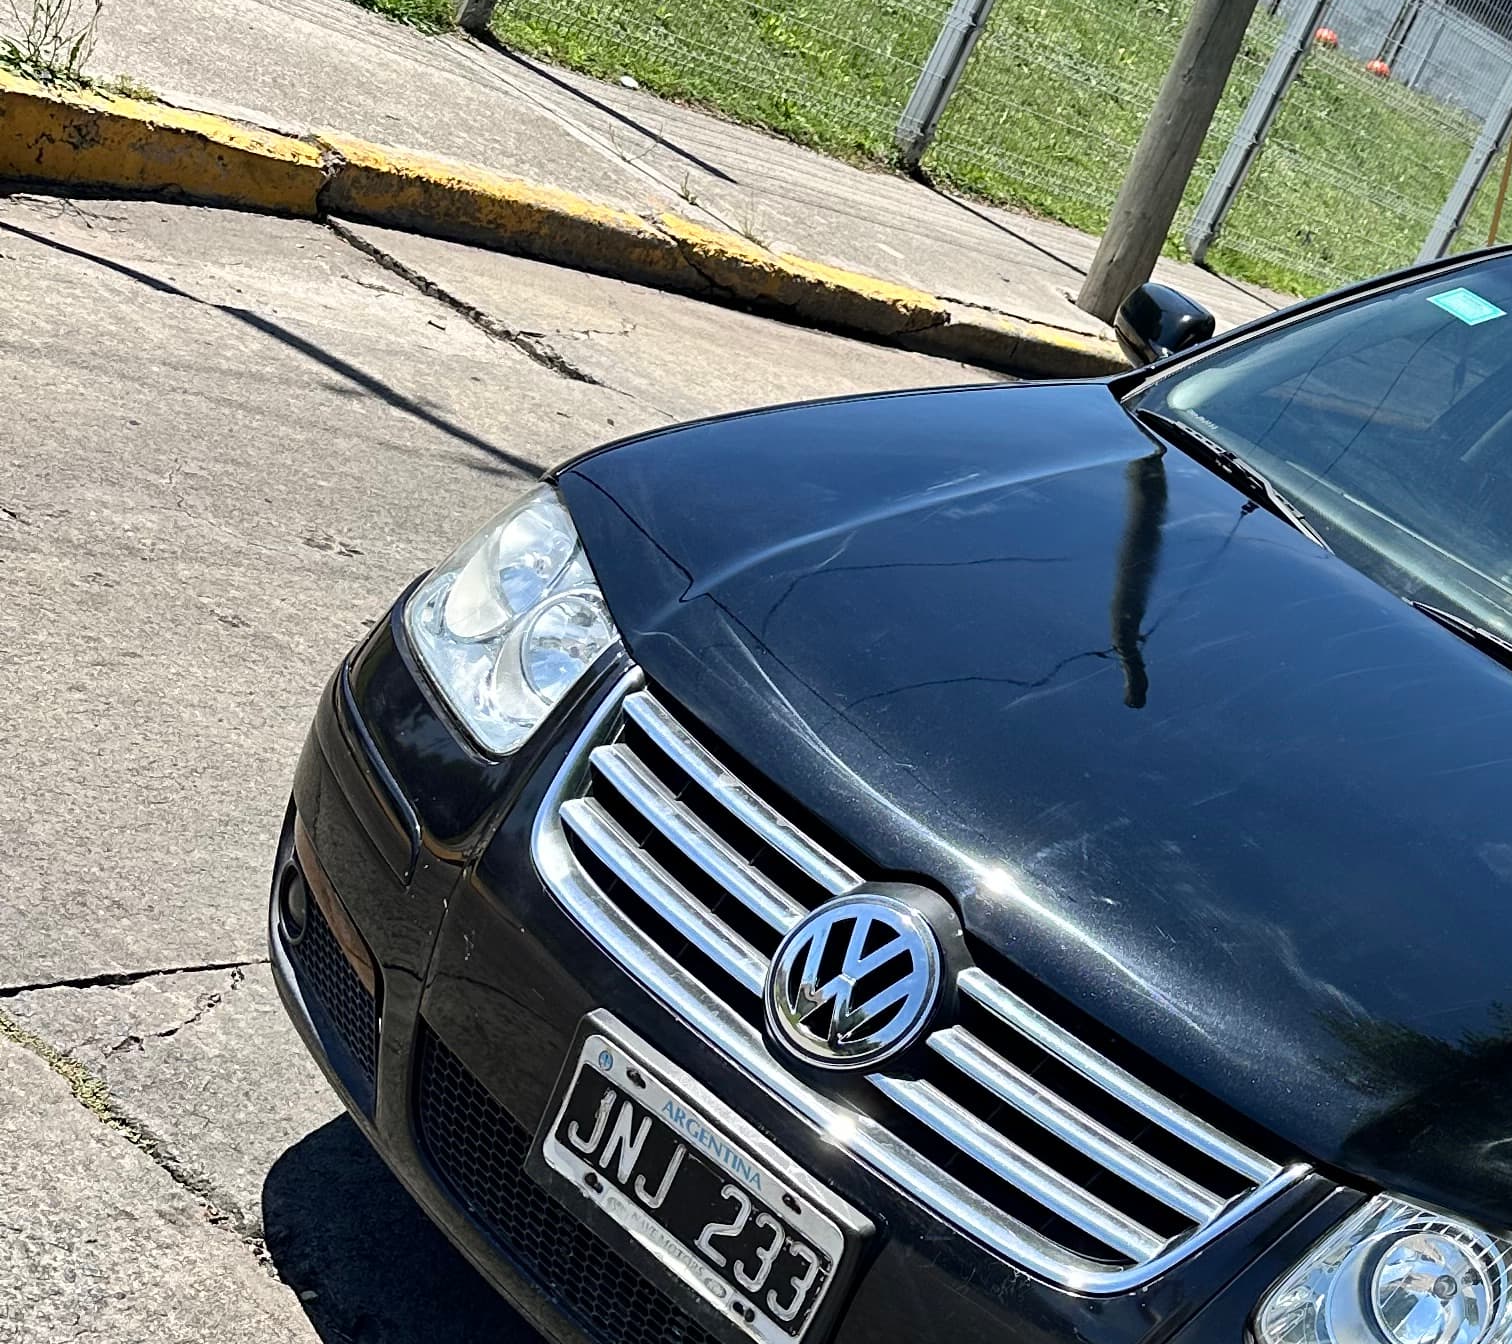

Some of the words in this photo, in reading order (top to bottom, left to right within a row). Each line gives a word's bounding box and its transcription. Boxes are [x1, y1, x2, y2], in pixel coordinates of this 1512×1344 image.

[567, 1089, 687, 1209] JNJ
[694, 1183, 821, 1322] 233
[662, 1099, 763, 1192] ARGENTINA
